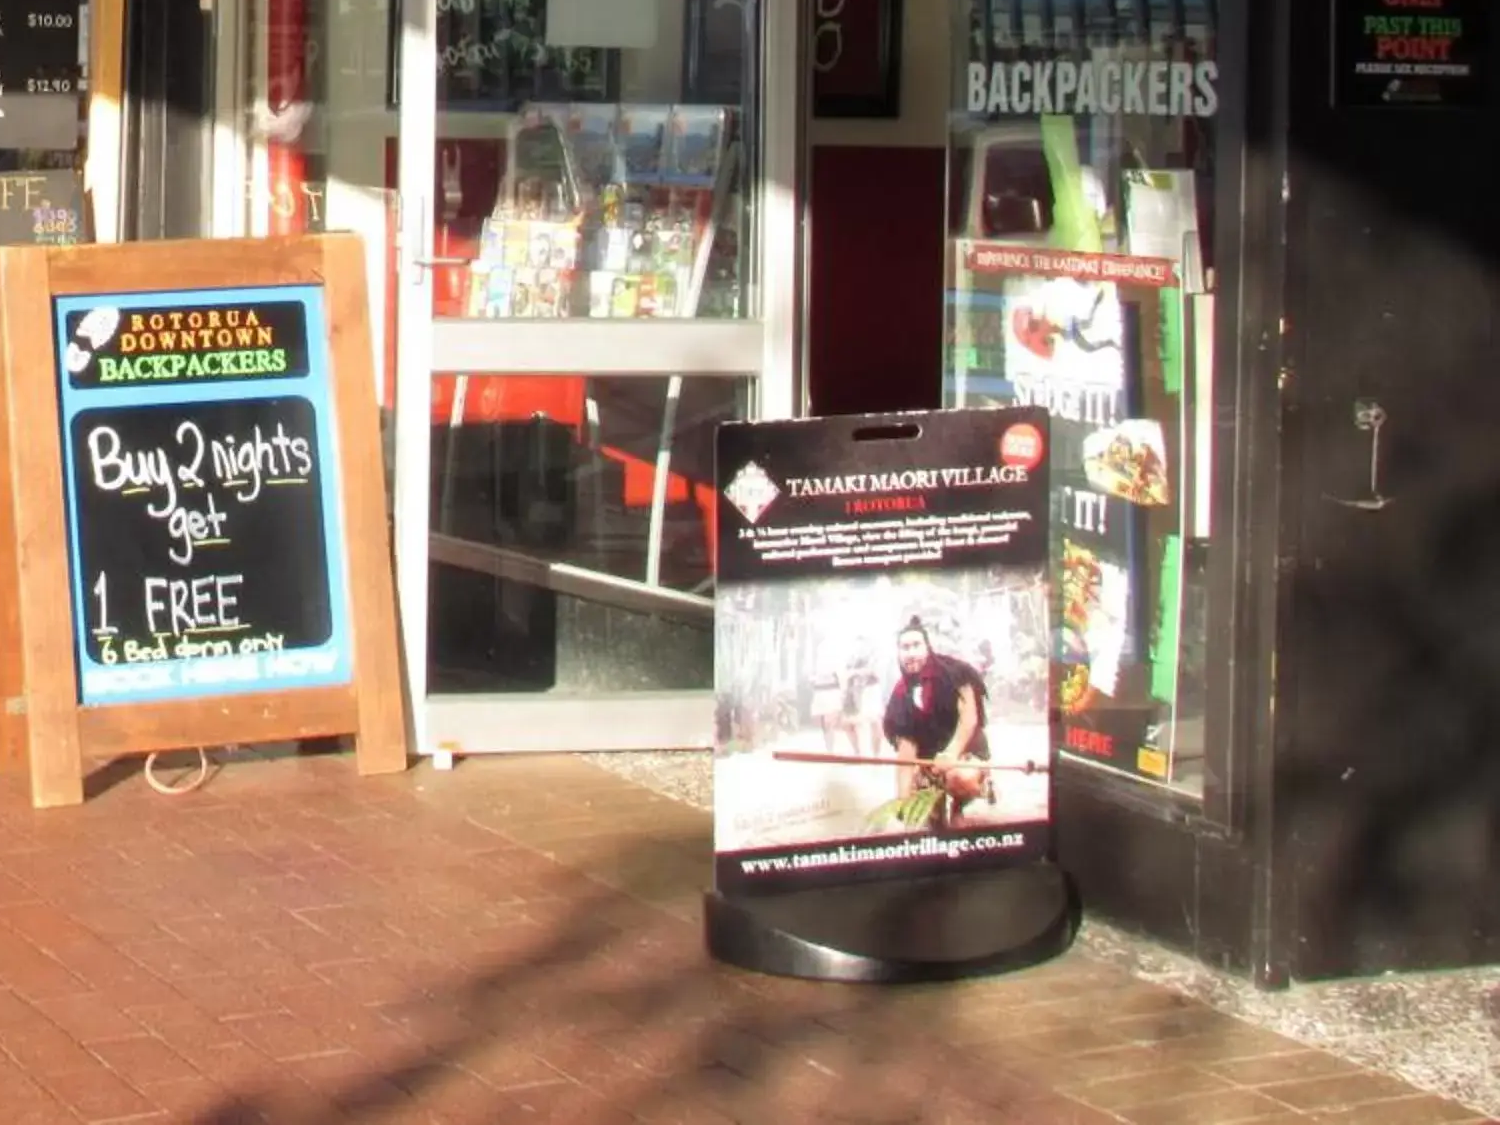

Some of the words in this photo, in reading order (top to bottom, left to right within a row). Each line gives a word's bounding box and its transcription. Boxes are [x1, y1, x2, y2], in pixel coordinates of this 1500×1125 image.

[967, 59, 1219, 117] BACKPACKERS
[119, 325, 275, 354] DOWNTOWN
[131, 308, 260, 332] ROTORUA
[99, 348, 288, 382] BACKPACKERS
[87, 425, 177, 518] Buy
[175, 420, 205, 488] 2
[211, 422, 313, 503] nights
[786, 474, 867, 497] TAMAKI
[870, 470, 938, 494] MAORI
[940, 464, 1029, 488] VILLAGE
[168, 492, 228, 566] get
[1073, 489, 1108, 536] IT!
[92, 571, 119, 637] 1
[144, 573, 246, 637] FREE
[100, 637, 118, 665] 6
[123, 636, 169, 664] Bed
[175, 633, 233, 660] dorm
[239, 631, 285, 653] only
[740, 831, 1025, 875] www.tamakimaorivillage.co.nz
